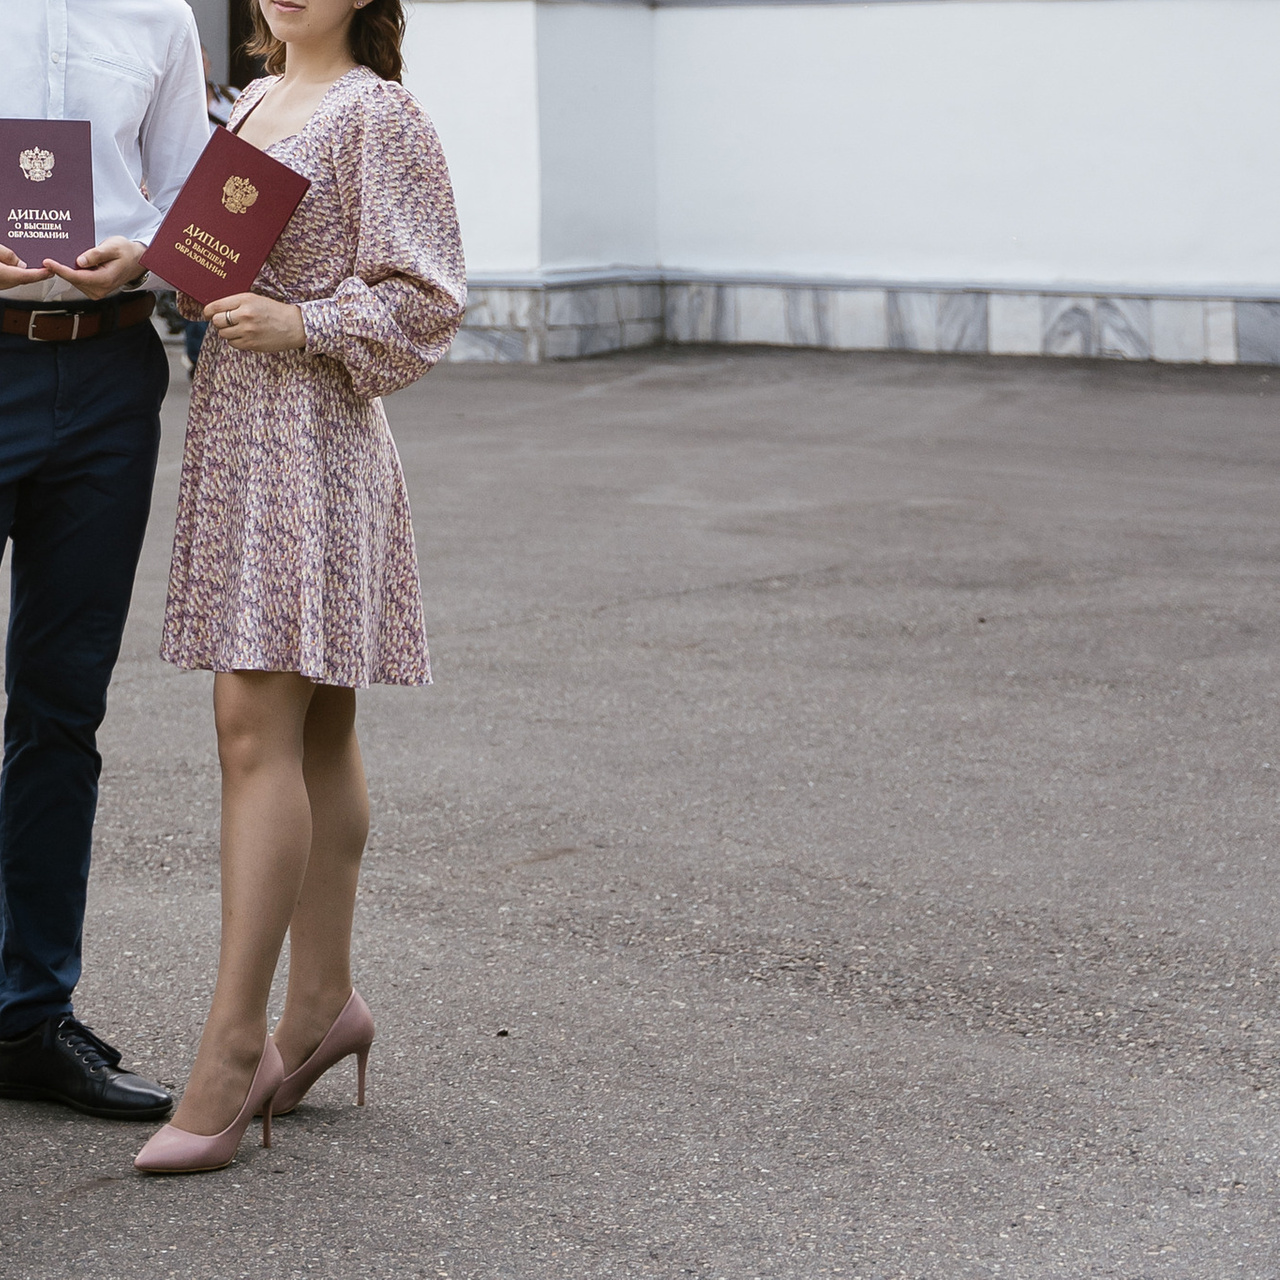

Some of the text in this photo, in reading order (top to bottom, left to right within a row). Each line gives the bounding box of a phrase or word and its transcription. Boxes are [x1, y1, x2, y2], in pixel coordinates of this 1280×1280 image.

[7, 209, 72, 222] ДИПЛОМ
[7, 231, 69, 240] ОБРАЗОВАНИИ
[24, 223, 62, 231] ВЫСШЕМ
[182, 223, 241, 264] ДИПЛОМ
[185, 238, 226, 268] О ВЫСШЕМ
[174, 242, 227, 280] ОБРАЗОВАНИИ
